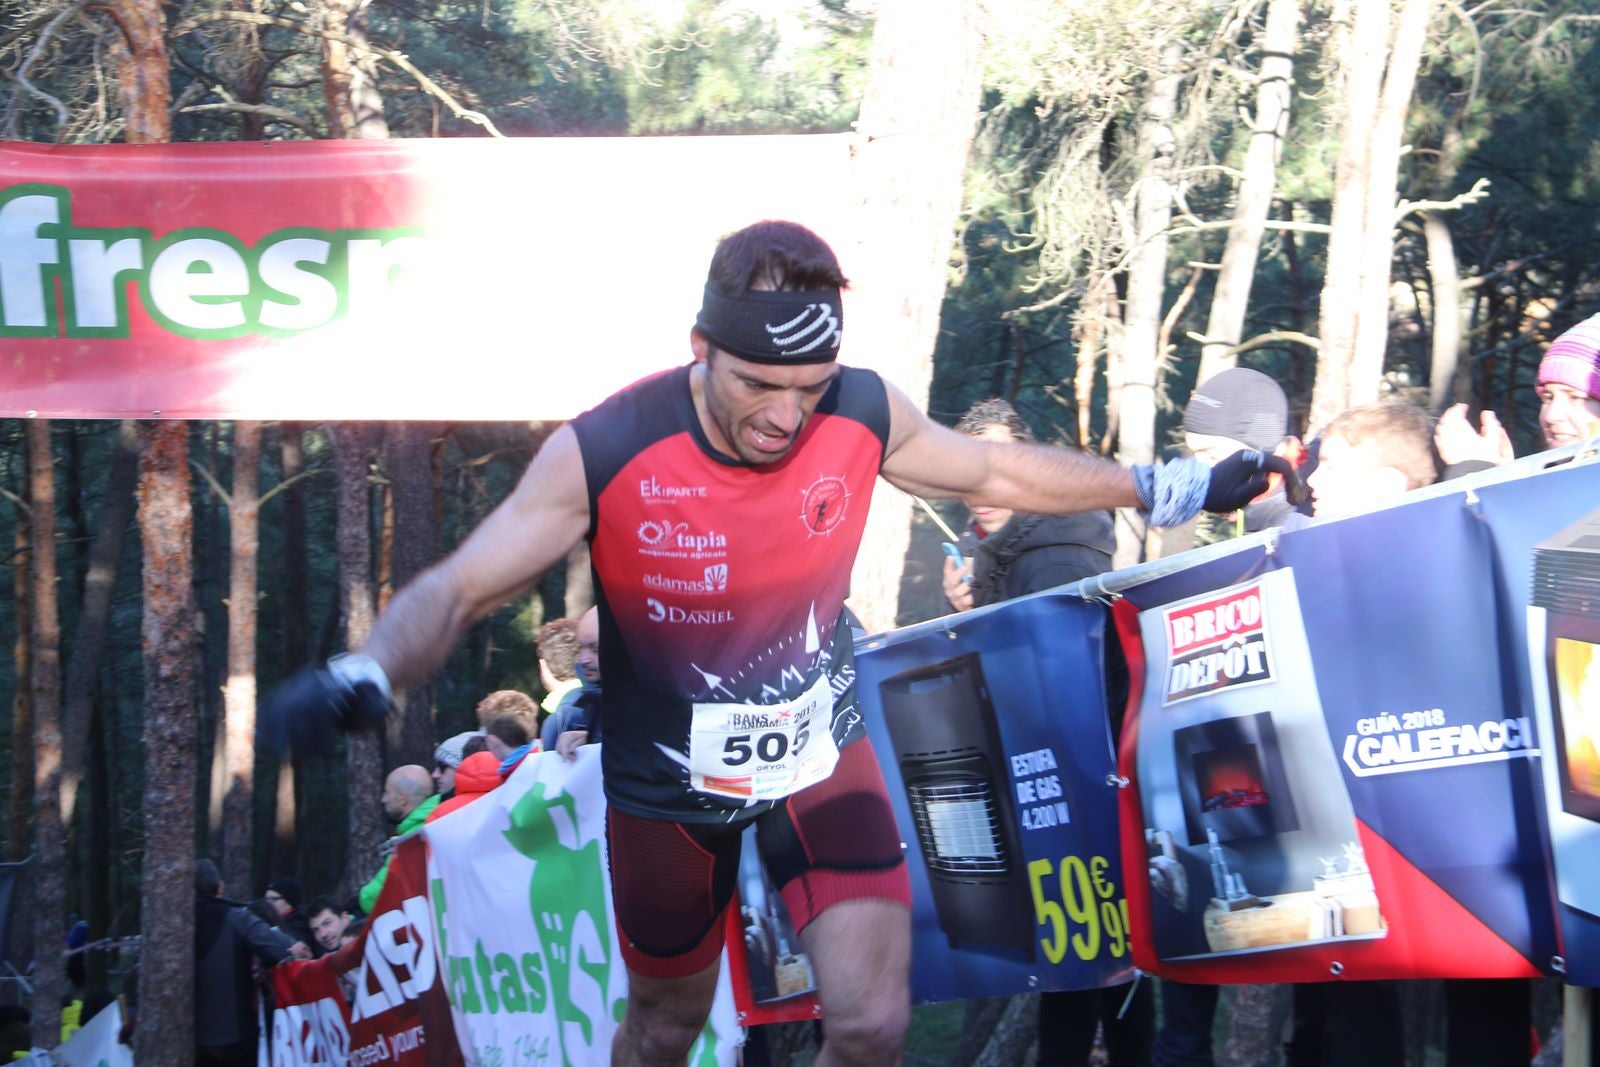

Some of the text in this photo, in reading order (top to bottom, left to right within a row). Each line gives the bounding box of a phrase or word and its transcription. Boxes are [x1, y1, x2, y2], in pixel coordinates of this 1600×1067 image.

[677, 531, 727, 551] tapia
[642, 573, 705, 592] adamas
[1171, 595, 1261, 649] BRICO
[1168, 633, 1266, 694] DEPÔT
[793, 701, 817, 724] 2019
[1356, 708, 1446, 736] GUÍA 2018
[721, 719, 810, 767] 505
[1358, 717, 1534, 767] CALEFACCI
[1010, 748, 1058, 777] ESTUFA
[1016, 775, 1063, 804] DE GAS
[1027, 855, 1101, 964] 59
